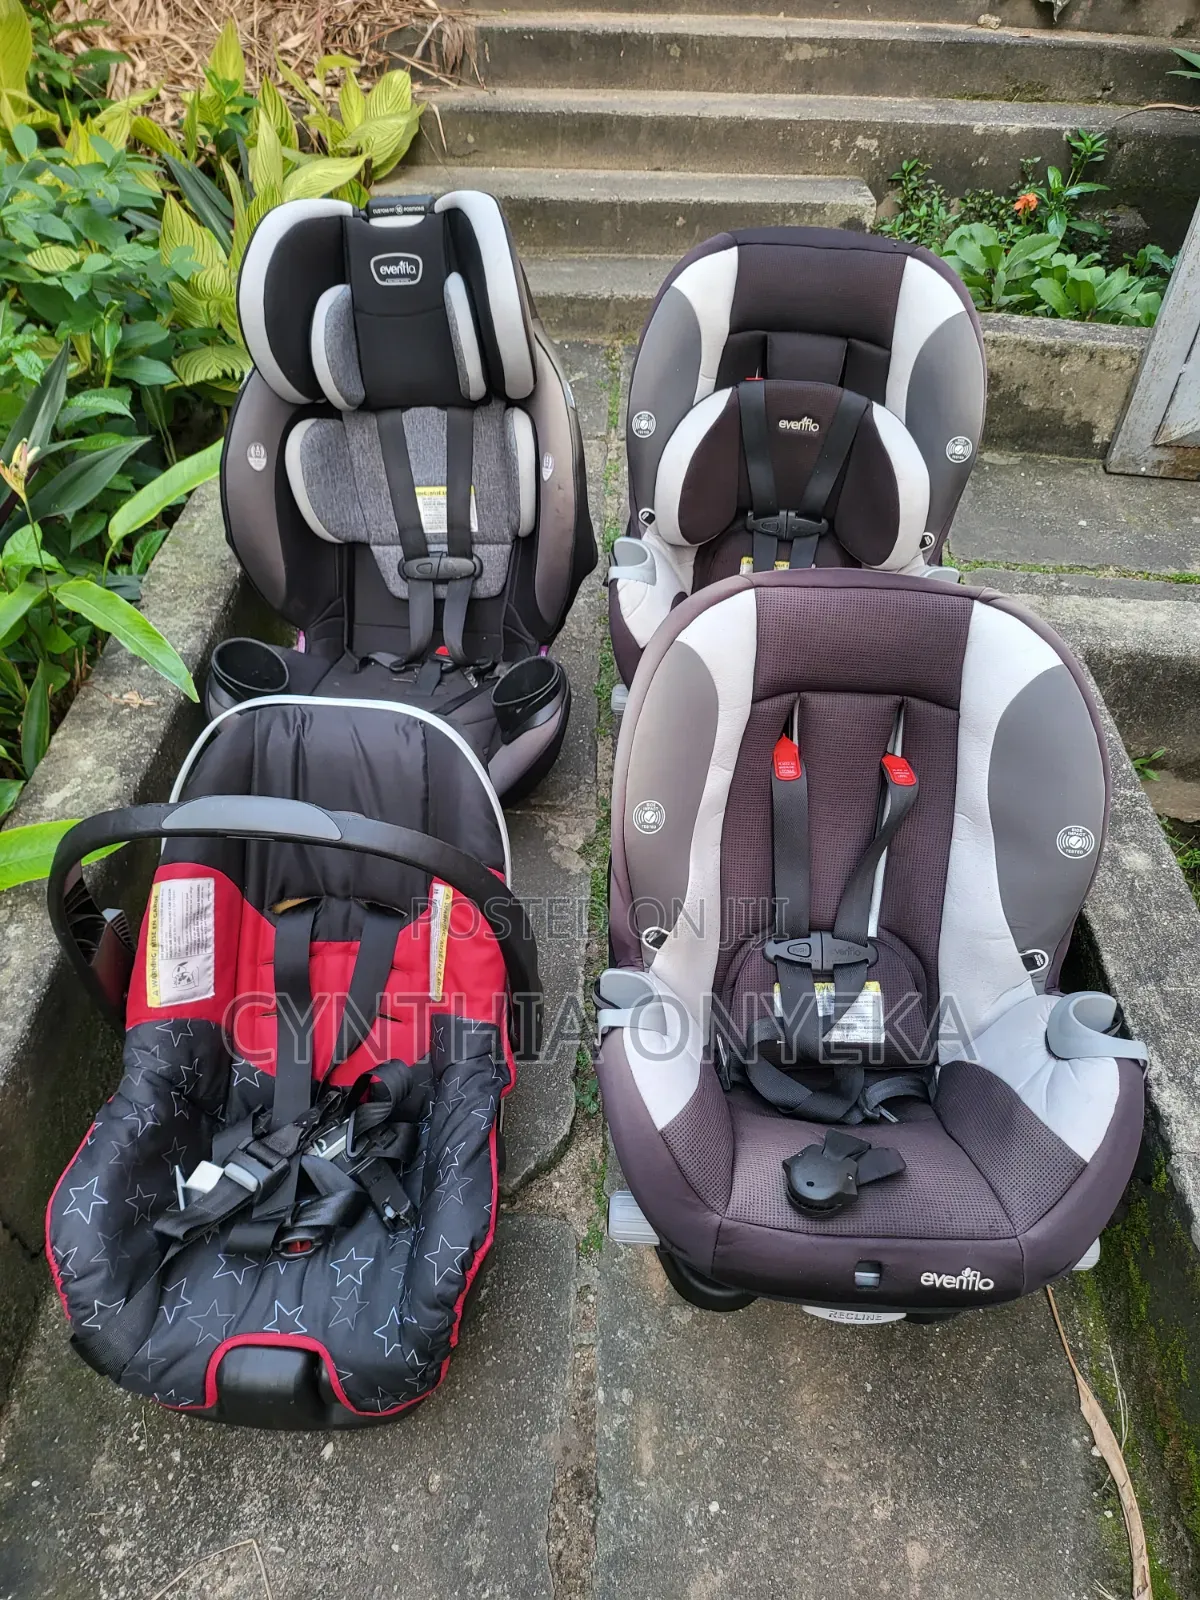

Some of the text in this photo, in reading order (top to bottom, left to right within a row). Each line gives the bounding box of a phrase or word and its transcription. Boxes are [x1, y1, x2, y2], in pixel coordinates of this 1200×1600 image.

[380, 260, 417, 275] evenflo
[778, 416, 820, 432] evenflo
[920, 1267, 995, 1291] evenflo
[828, 1310, 883, 1322] RECLINE
